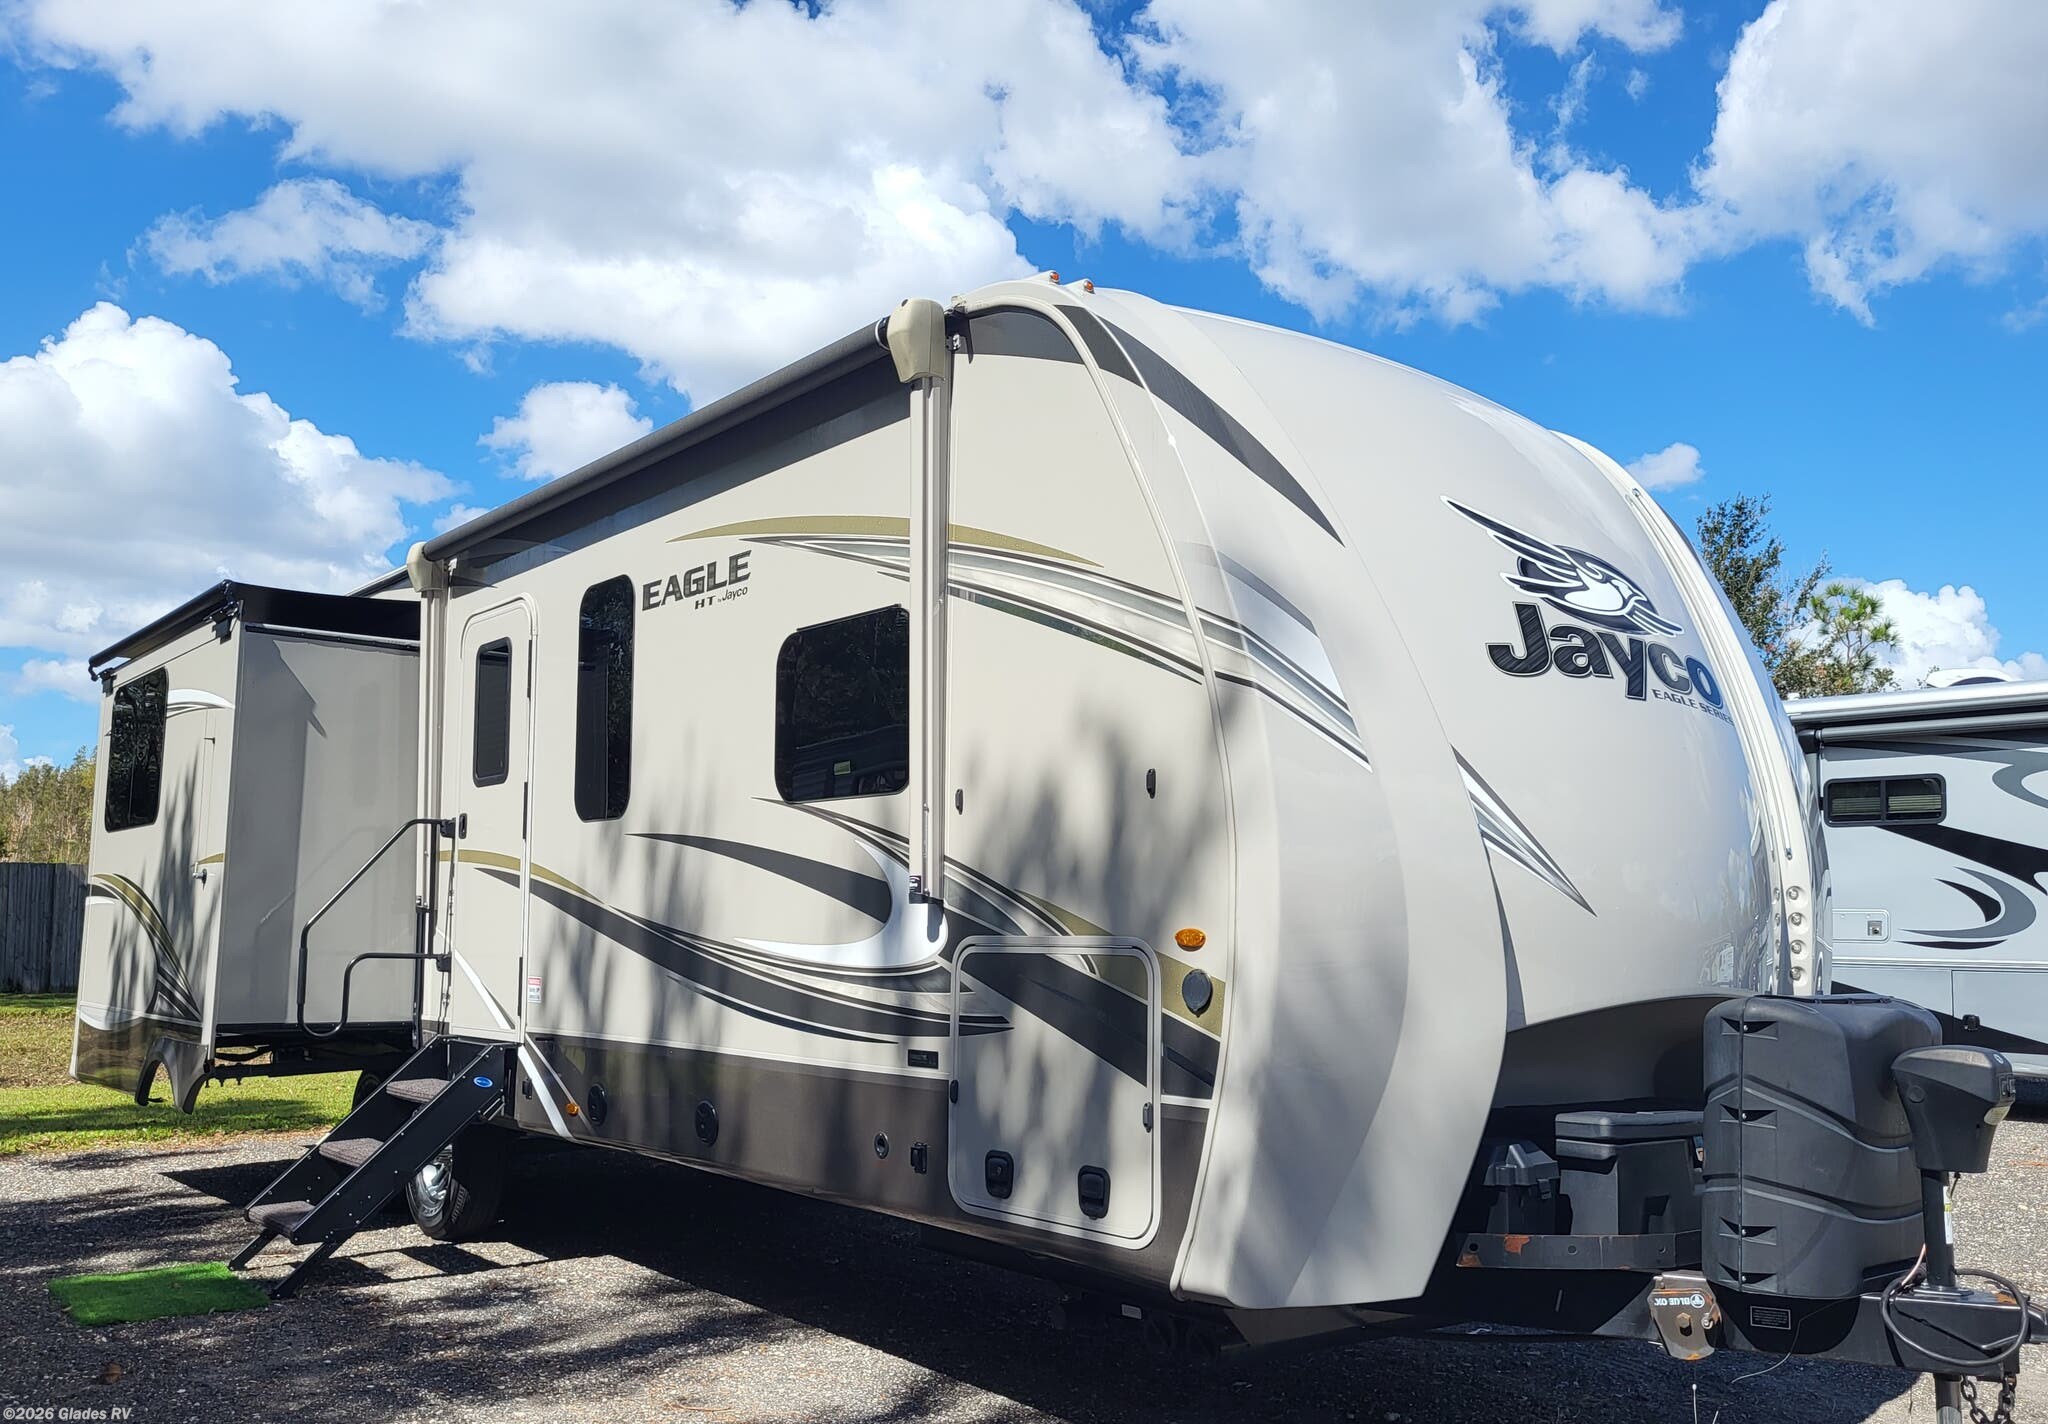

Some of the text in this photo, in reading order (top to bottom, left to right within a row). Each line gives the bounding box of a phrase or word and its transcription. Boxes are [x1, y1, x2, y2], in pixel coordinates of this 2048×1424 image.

[642, 549, 752, 611] EAGLE
[695, 586, 748, 610] HT Jayco
[1485, 601, 1724, 709] Jayco
[1652, 689, 1734, 727] EAGLE SERIES
[1669, 1297, 1690, 1306] BLUE
